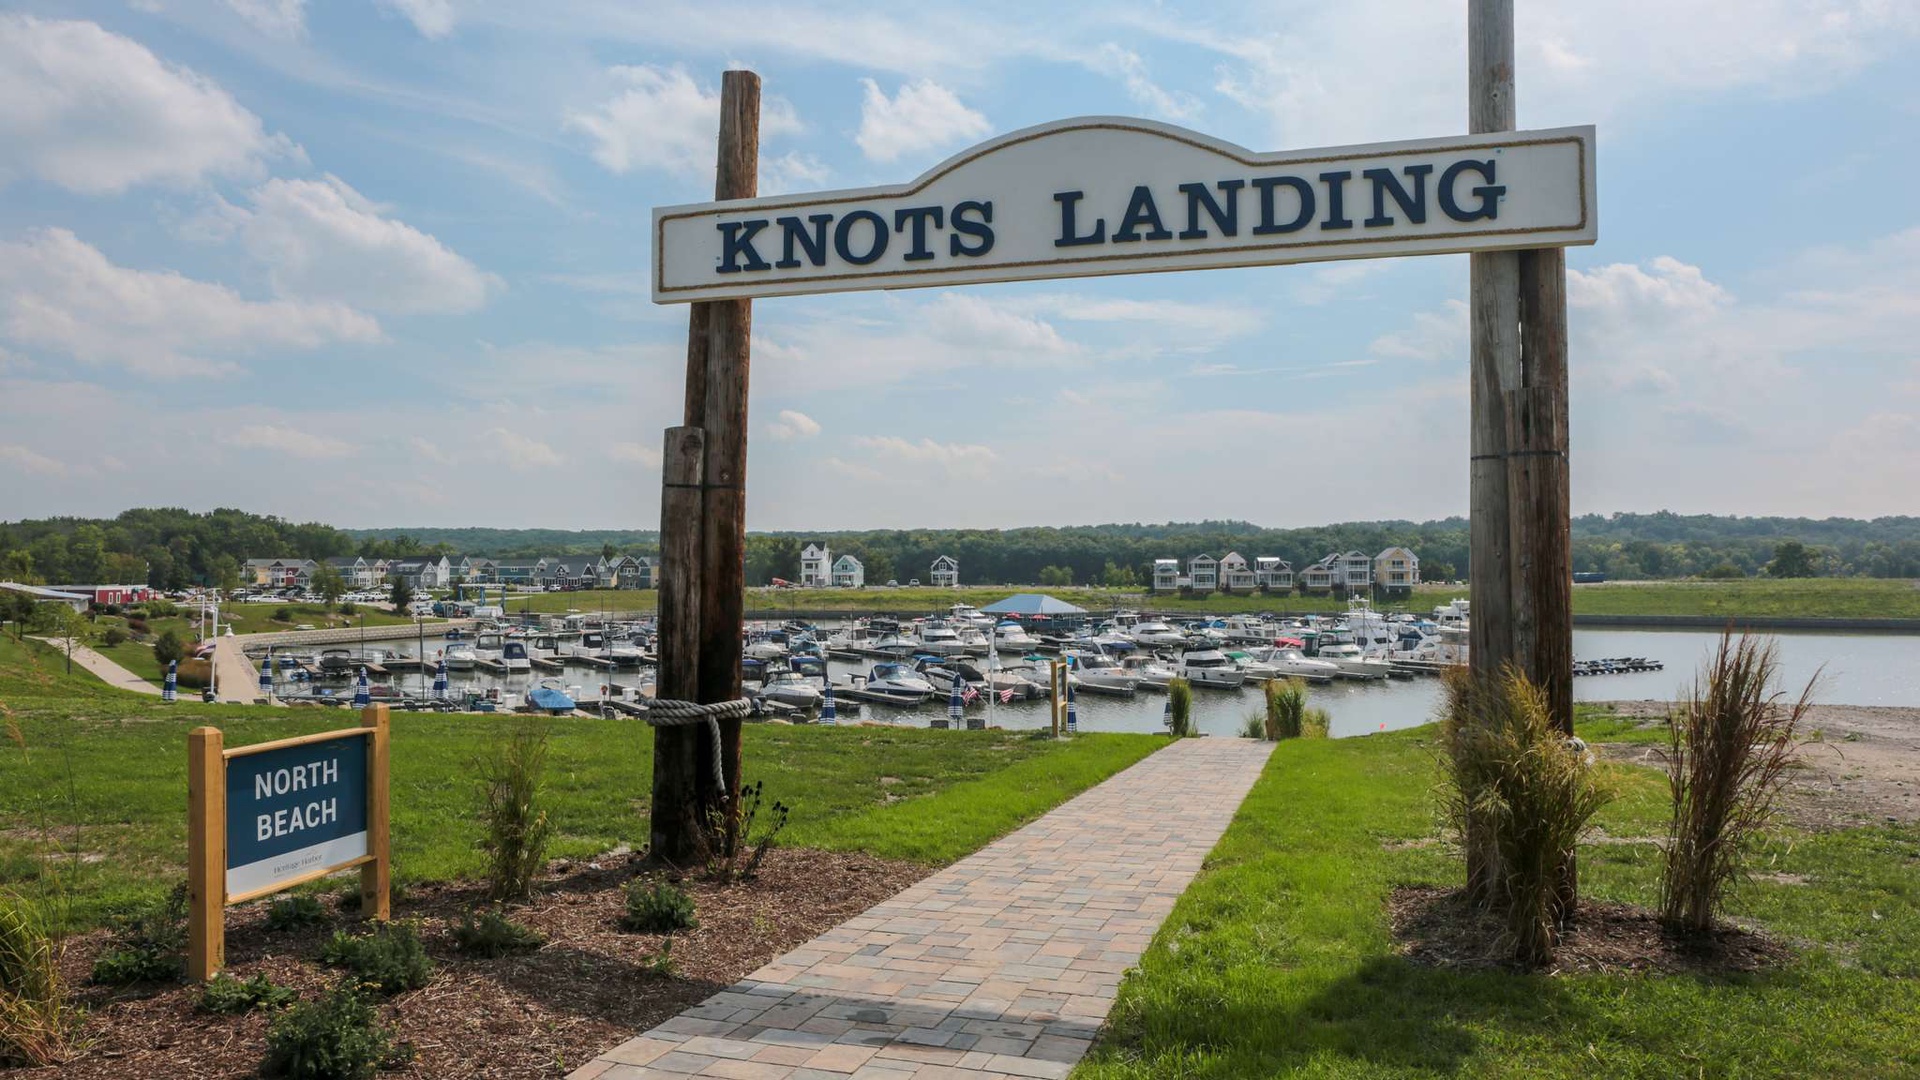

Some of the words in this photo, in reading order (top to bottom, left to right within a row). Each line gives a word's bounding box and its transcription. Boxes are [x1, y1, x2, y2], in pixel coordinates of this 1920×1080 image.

[716, 201, 996, 274] KNOTS
[1053, 159, 1507, 248] LANDING
[255, 758, 338, 800] NORTH
[257, 797, 337, 842] BEACH
